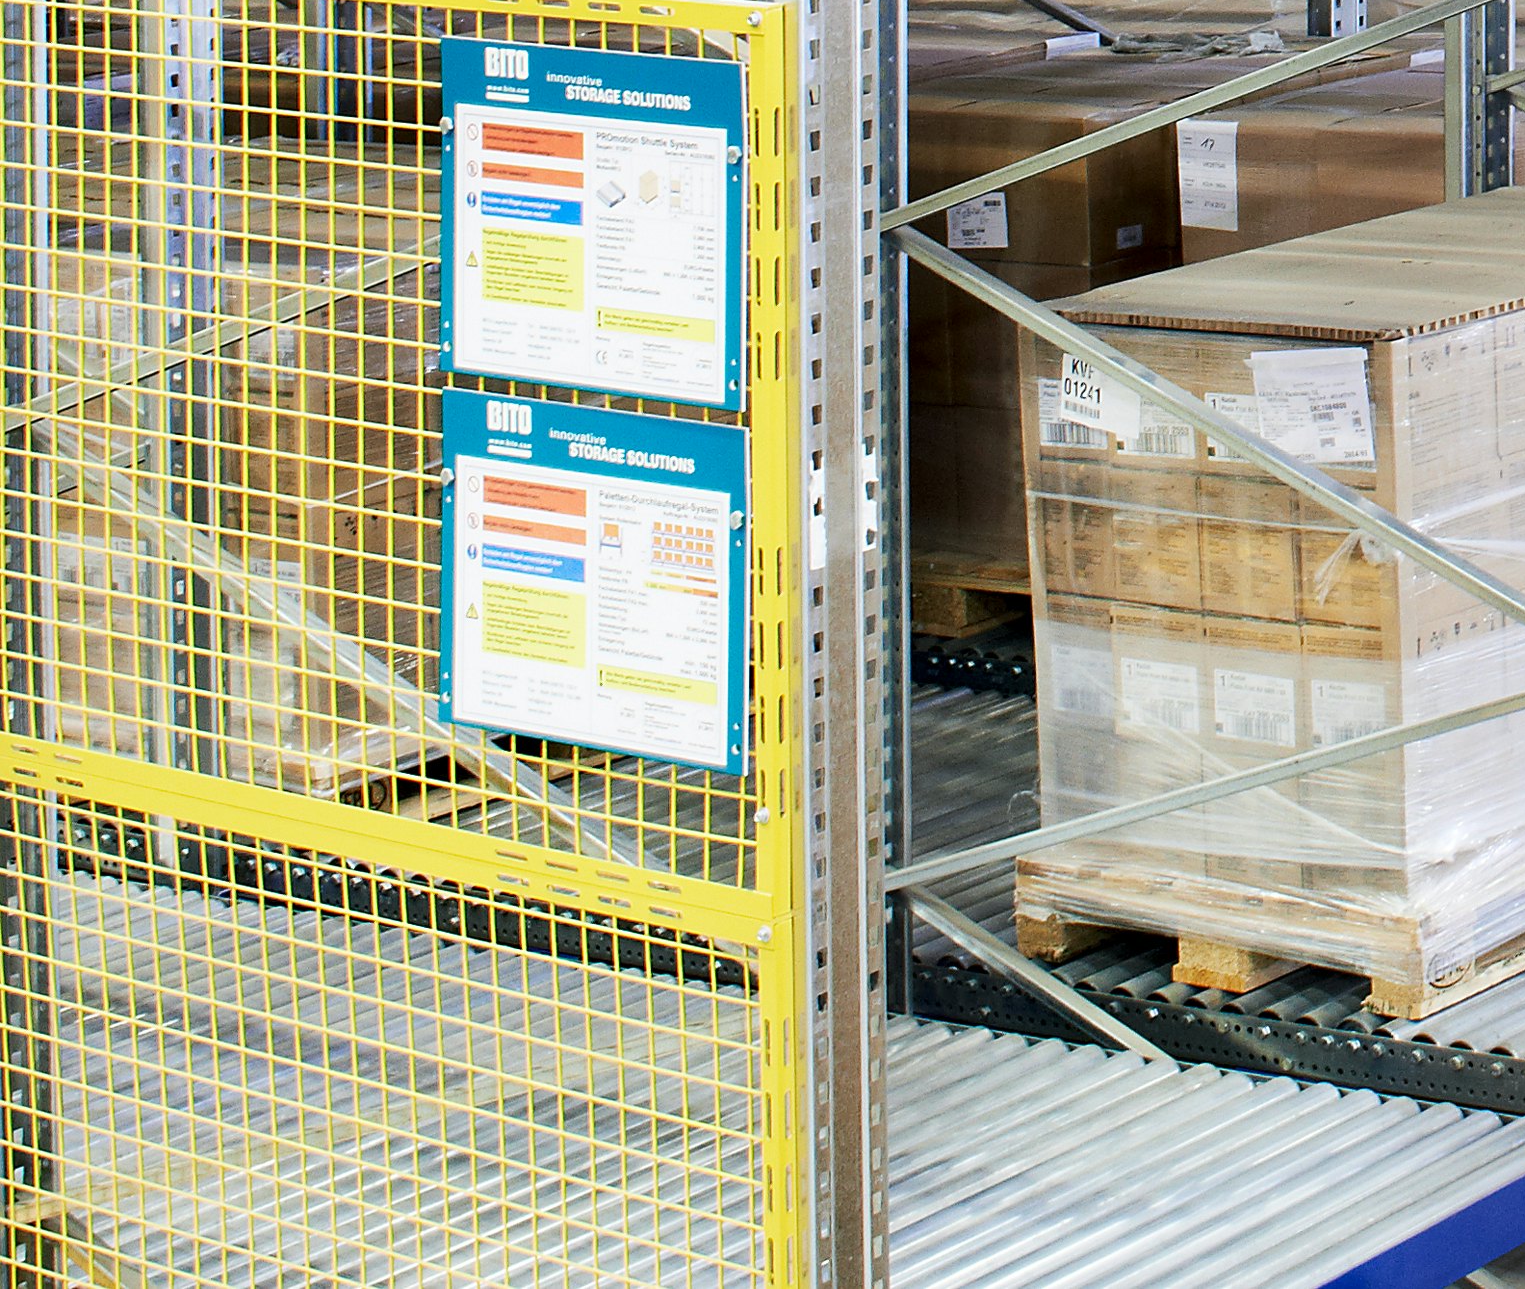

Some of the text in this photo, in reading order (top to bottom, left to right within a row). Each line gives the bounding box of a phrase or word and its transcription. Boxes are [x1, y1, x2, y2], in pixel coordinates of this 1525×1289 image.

[484, 46, 530, 80] BITO
[546, 71, 602, 86] innovative
[565, 86, 691, 111] STORAGE SOLUTIONS
[596, 131, 698, 150] PROmotion Shuttle System
[1064, 377, 1101, 404] 01241
[486, 400, 532, 436] BITO
[549, 427, 606, 446] innovative
[569, 442, 695, 474] STORAGE SOLUTIONS
